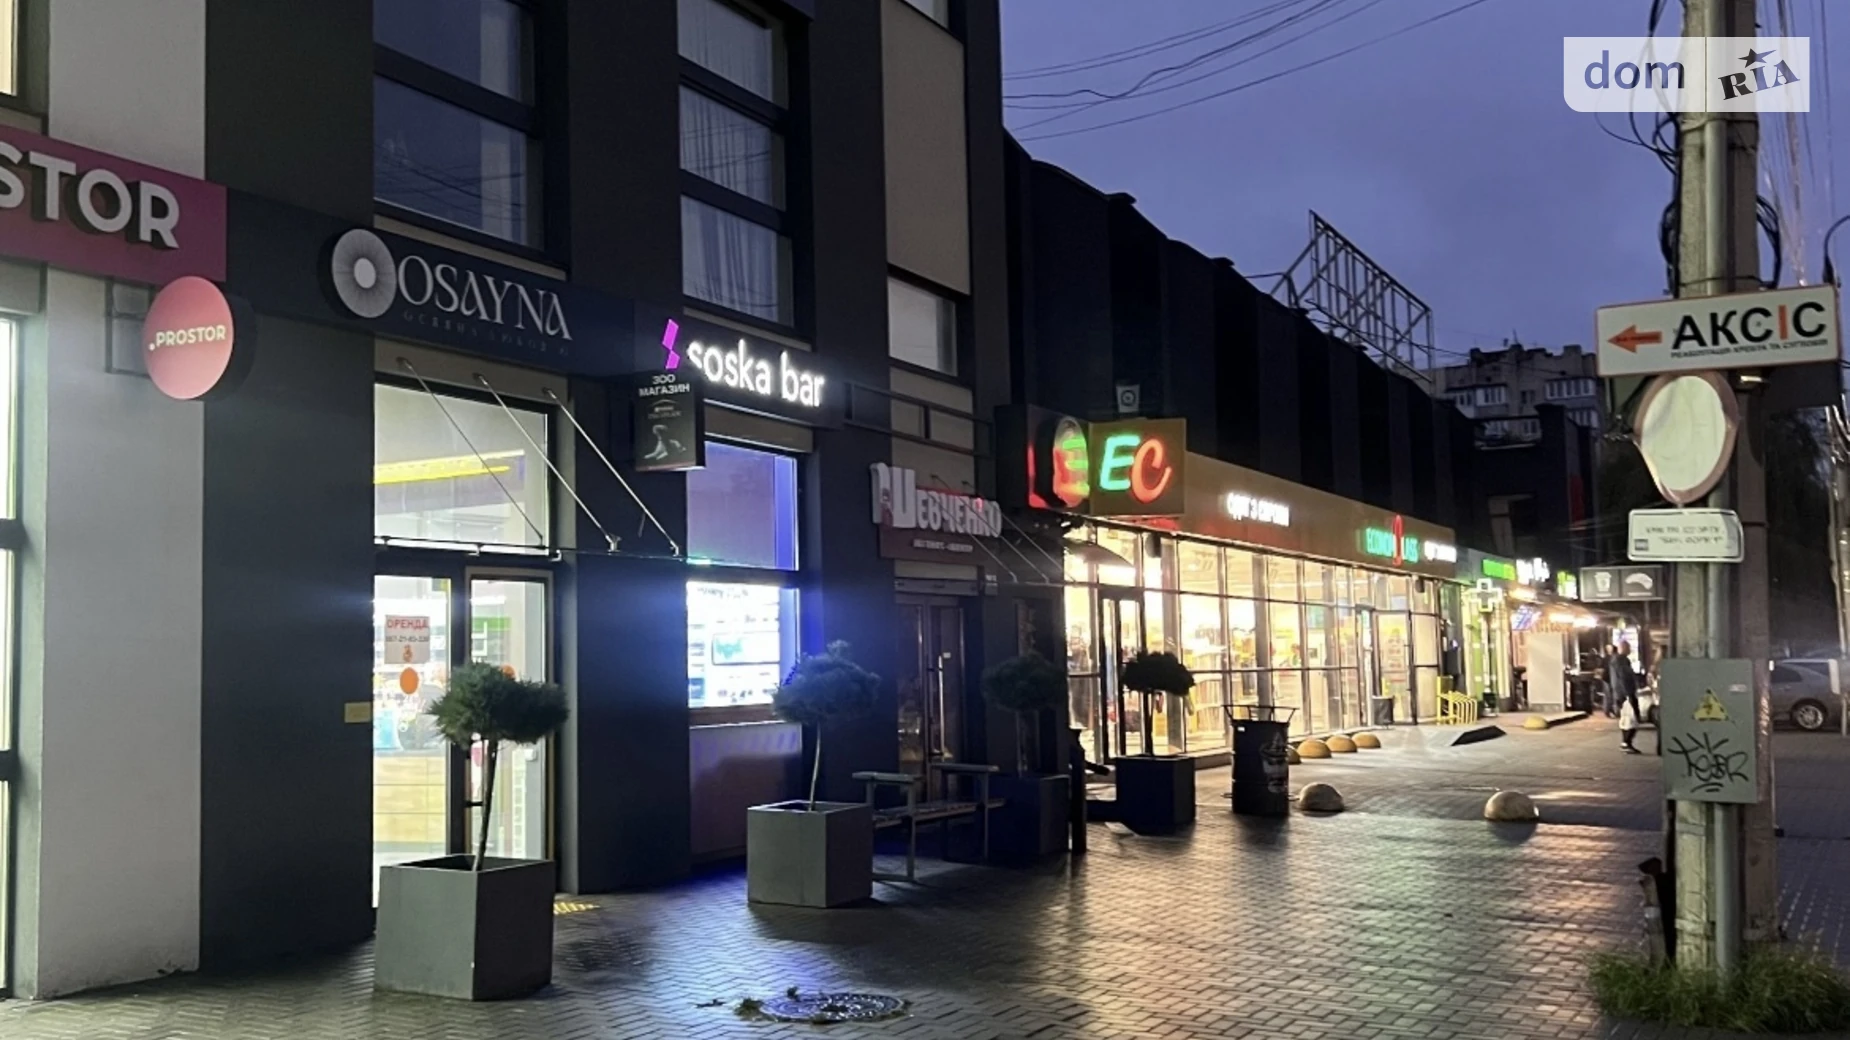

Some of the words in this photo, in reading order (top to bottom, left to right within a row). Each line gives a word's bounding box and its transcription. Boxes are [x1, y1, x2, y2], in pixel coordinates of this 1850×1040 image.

[398, 255, 573, 340] OSAYNA
[639, 383, 691, 397] МАГАЗИН
[780, 350, 825, 408] bar
[387, 619, 429, 631] ОРЕНДА
